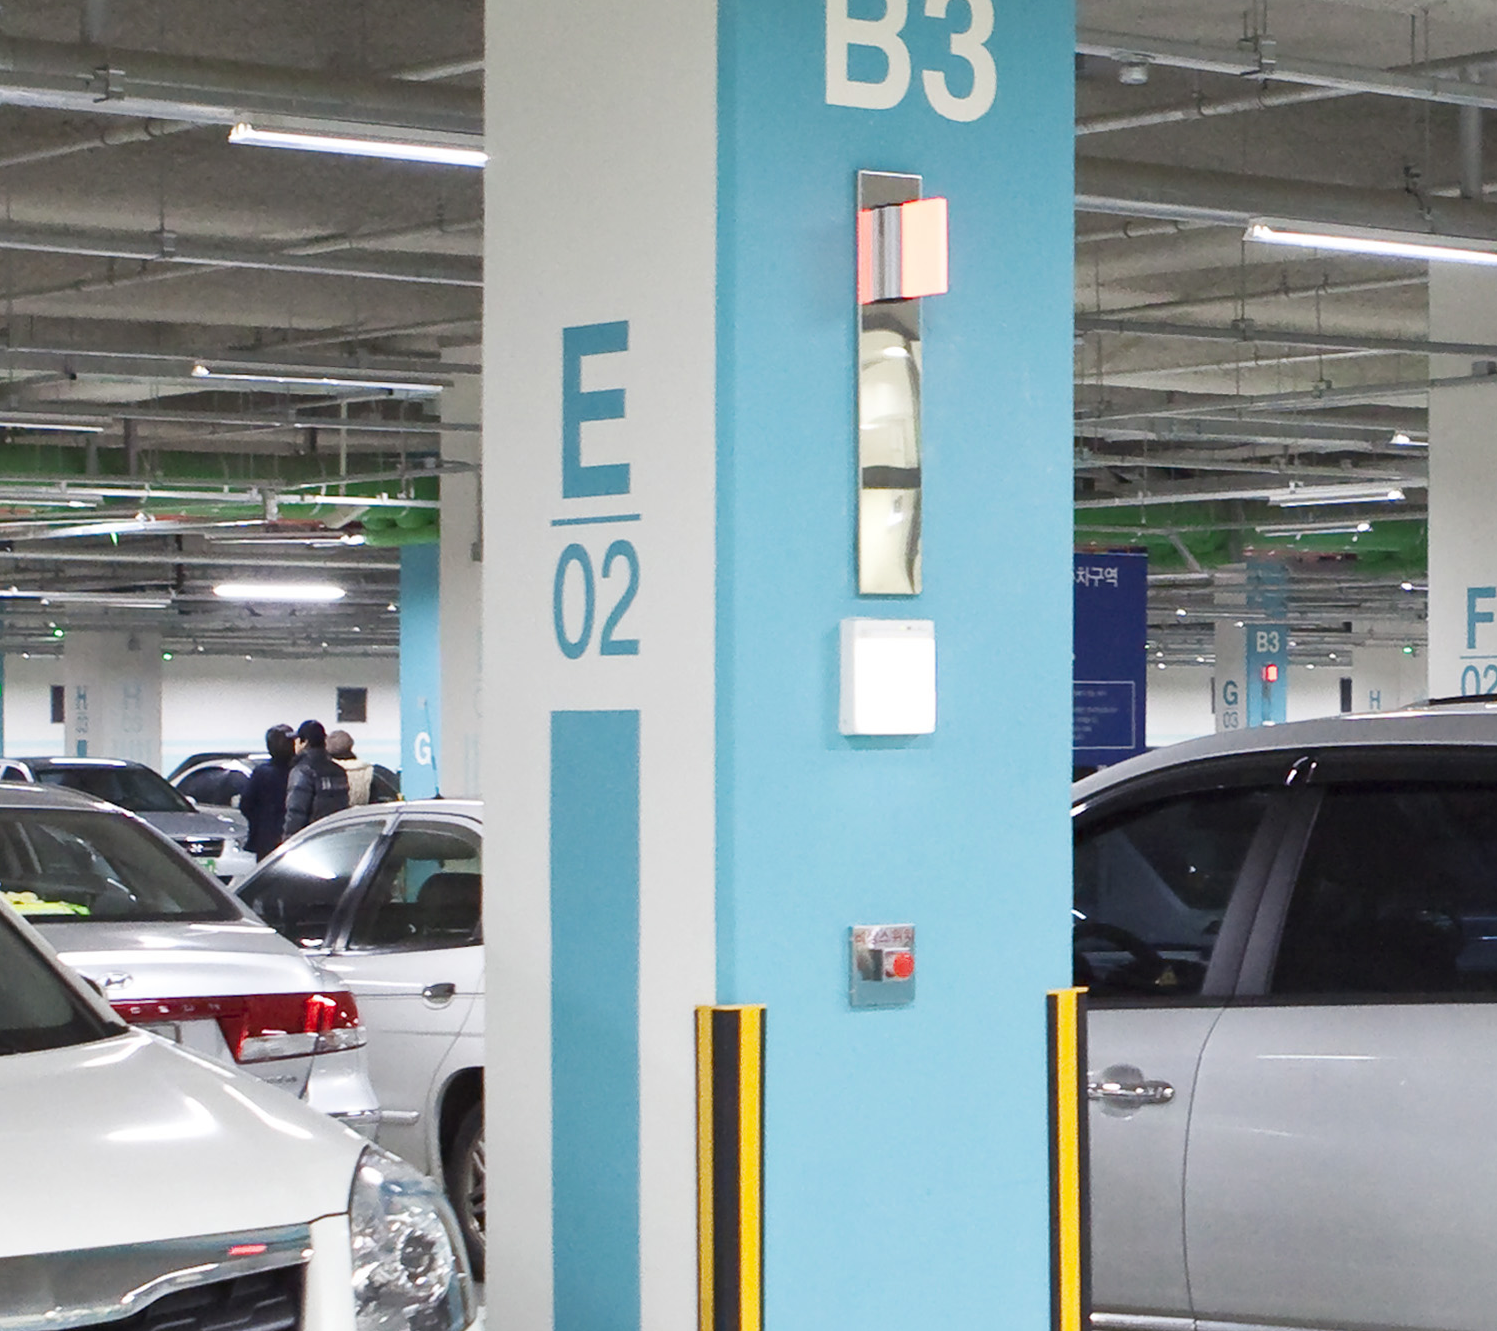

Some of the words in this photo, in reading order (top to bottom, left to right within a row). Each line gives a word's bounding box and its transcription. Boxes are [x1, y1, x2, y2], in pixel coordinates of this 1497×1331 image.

[562, 320, 631, 500] E
[1074, 566, 1119, 588] 차구역
[553, 539, 642, 660] 02
[1466, 586, 1497, 650] F
[1256, 631, 1280, 653] B3
[1222, 680, 1239, 707] G
[1369, 690, 1382, 711] H
[414, 731, 432, 766] G
